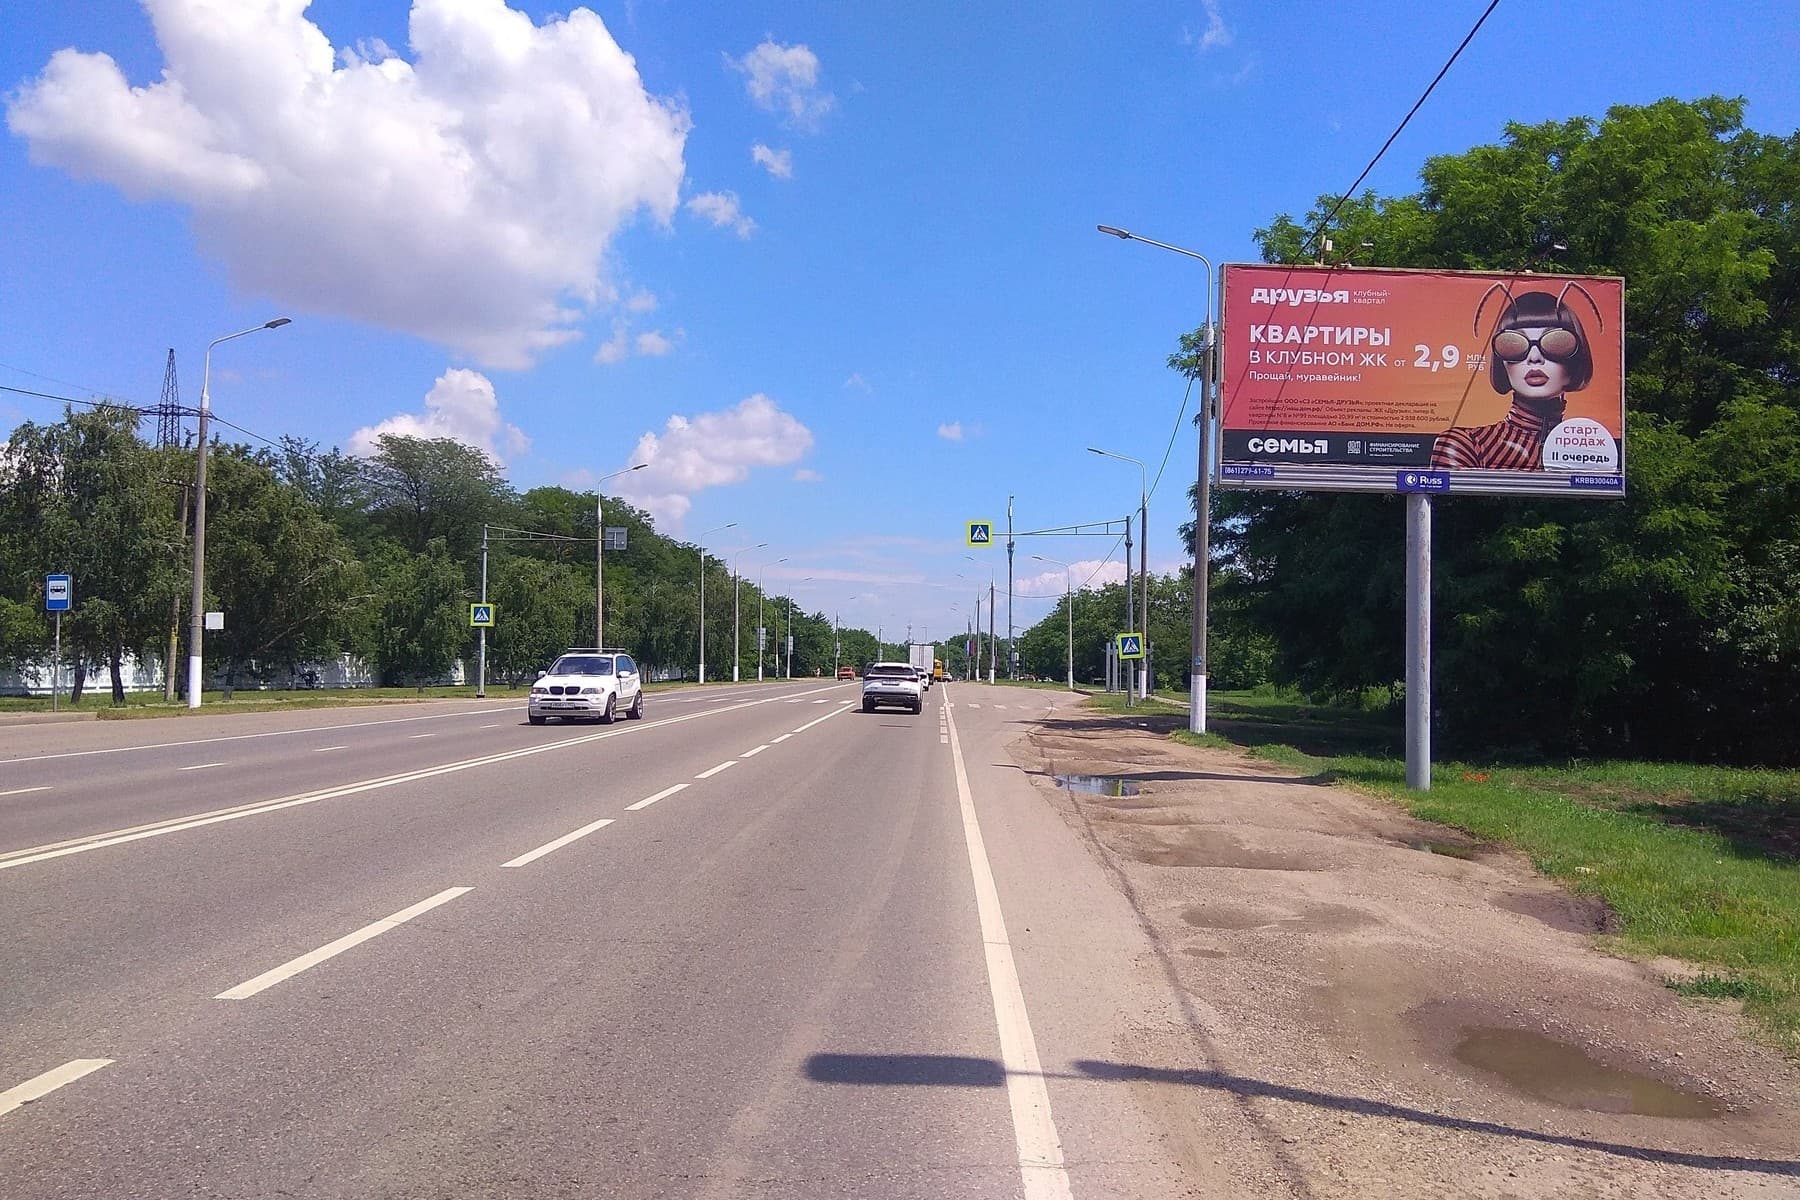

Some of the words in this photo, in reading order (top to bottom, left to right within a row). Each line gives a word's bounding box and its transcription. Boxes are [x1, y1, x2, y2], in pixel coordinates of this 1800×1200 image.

[1250, 288, 1349, 306] друзья
[1250, 325, 1390, 346] КВАРТИРЫ
[1249, 350, 1260, 364] В
[1266, 351, 1354, 366] КЛУБНОМ
[1360, 353, 1387, 367] ЖК
[1414, 344, 1460, 372] 2,9
[1249, 371, 1293, 381] Прощай,
[1296, 373, 1361, 383] муравейник!
[1563, 426, 1599, 436] старт
[1248, 438, 1328, 454] семья
[1555, 437, 1606, 447] продаж
[1562, 454, 1610, 464] очередь
[1419, 476, 1442, 485] Russ
